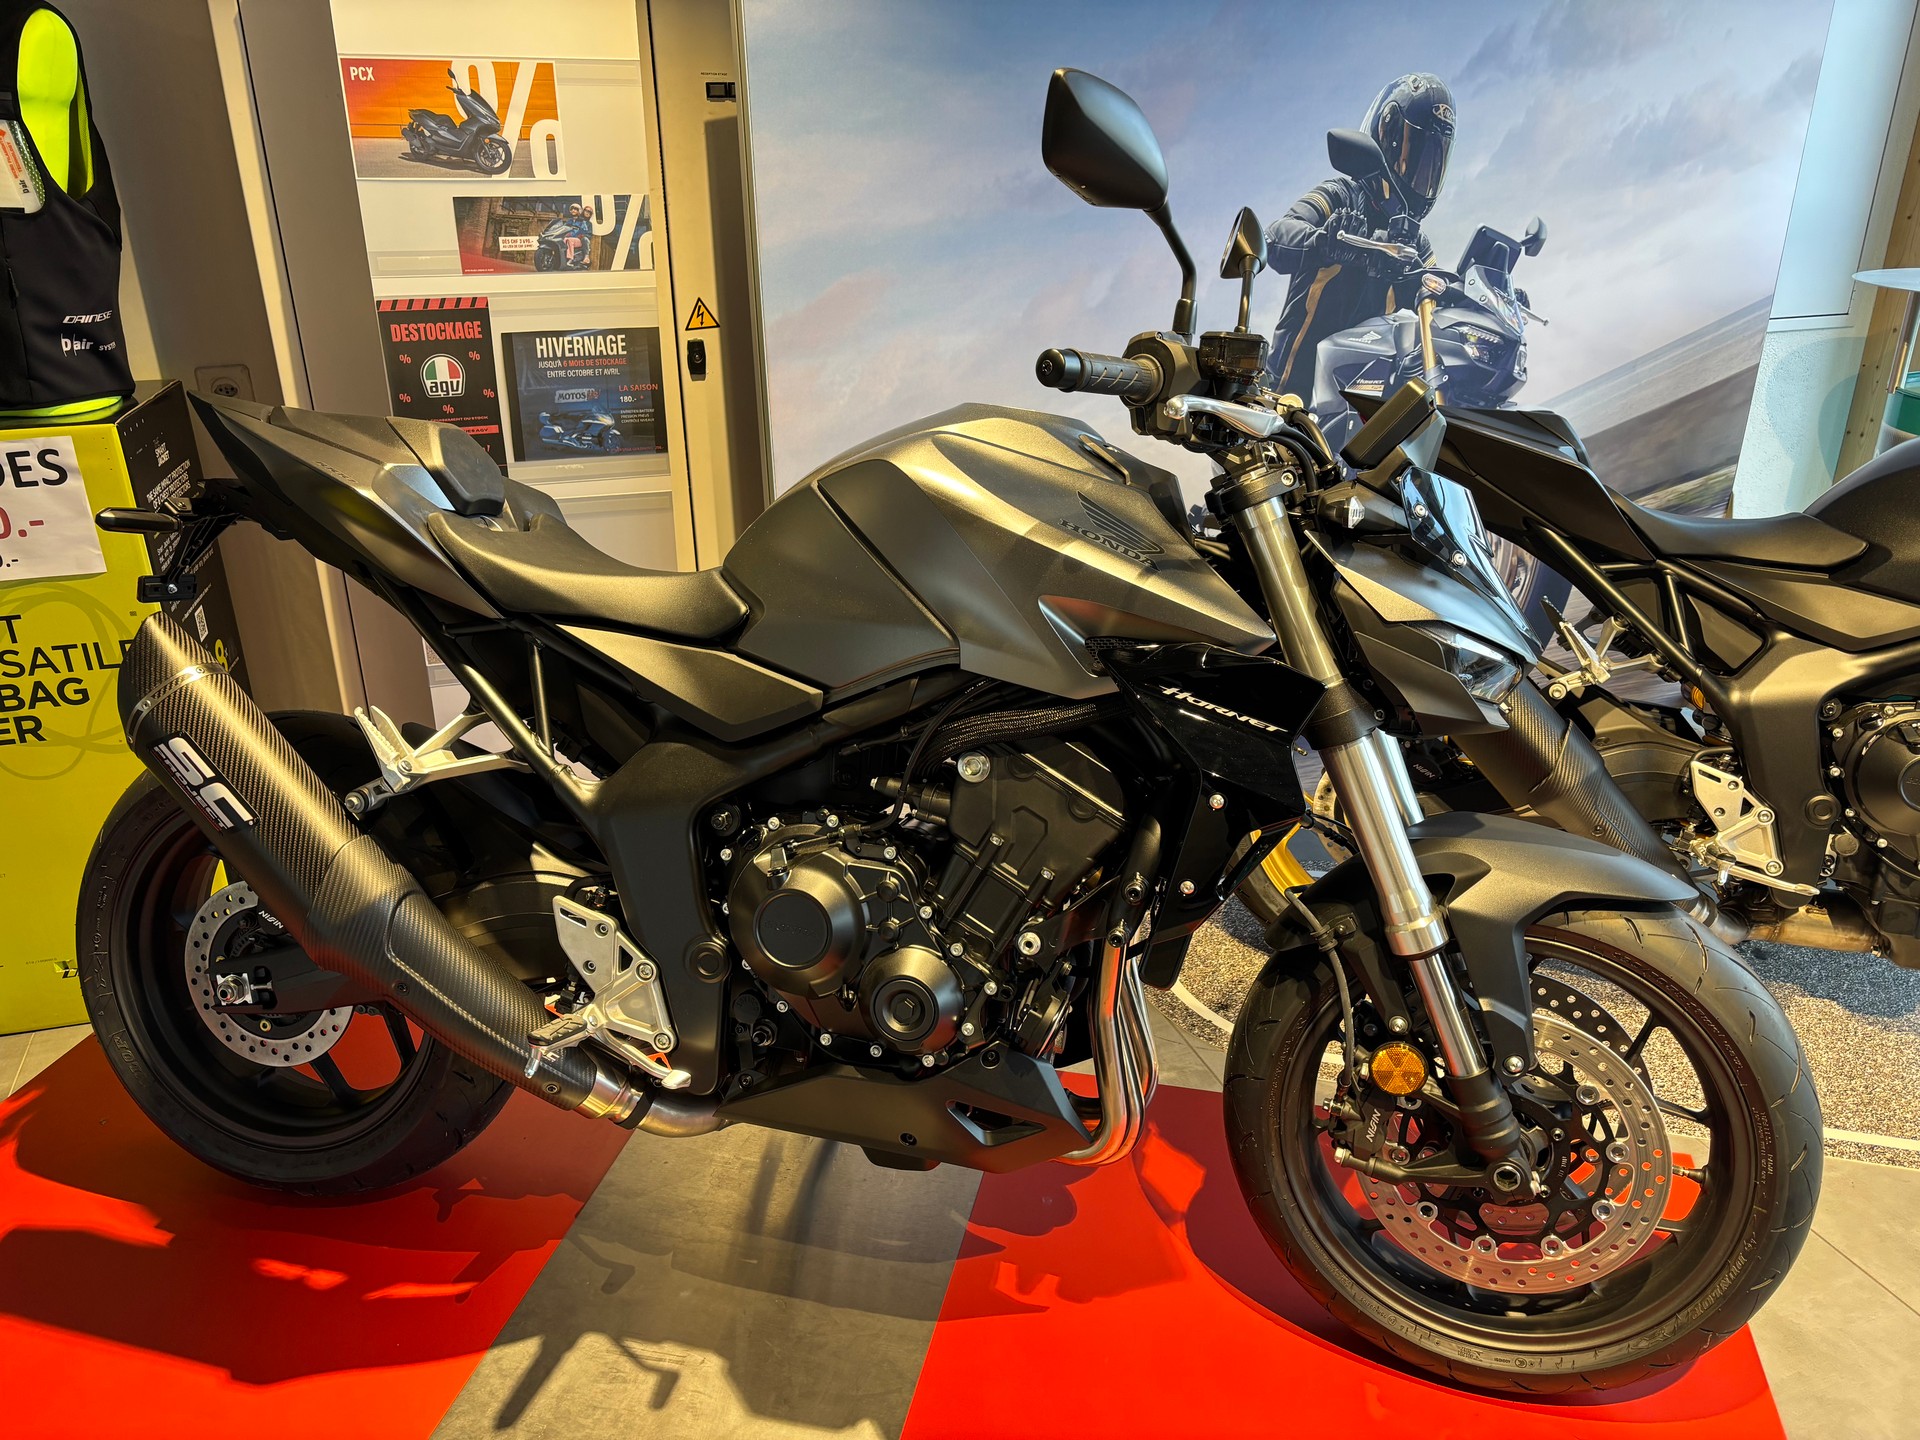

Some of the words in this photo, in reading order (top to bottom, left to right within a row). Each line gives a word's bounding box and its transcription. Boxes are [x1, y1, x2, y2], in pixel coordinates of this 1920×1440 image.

[350, 66, 375, 82] PCX
[62, 310, 113, 324] DAINESE
[390, 321, 483, 342] DESTOCKAGE
[535, 334, 628, 358] HIVERNAGE
[563, 359, 568, 367] 6
[568, 359, 585, 367] MOIS
[585, 358, 595, 367] DE
[595, 357, 628, 366] STOCKAGE
[547, 369, 567, 378] ENTRE
[567, 368, 594, 377] OCTOBRE
[595, 368, 603, 376] ET
[603, 367, 621, 376] AVRIL
[429, 380, 460, 396] agv
[557, 391, 586, 401] MOTOS
[630, 384, 659, 392] SAISON
[0, 448, 68, 488] ES
[1058, 518, 1161, 572] HONDA
[0, 677, 90, 713] BAG
[158, 737, 253, 829] SC
